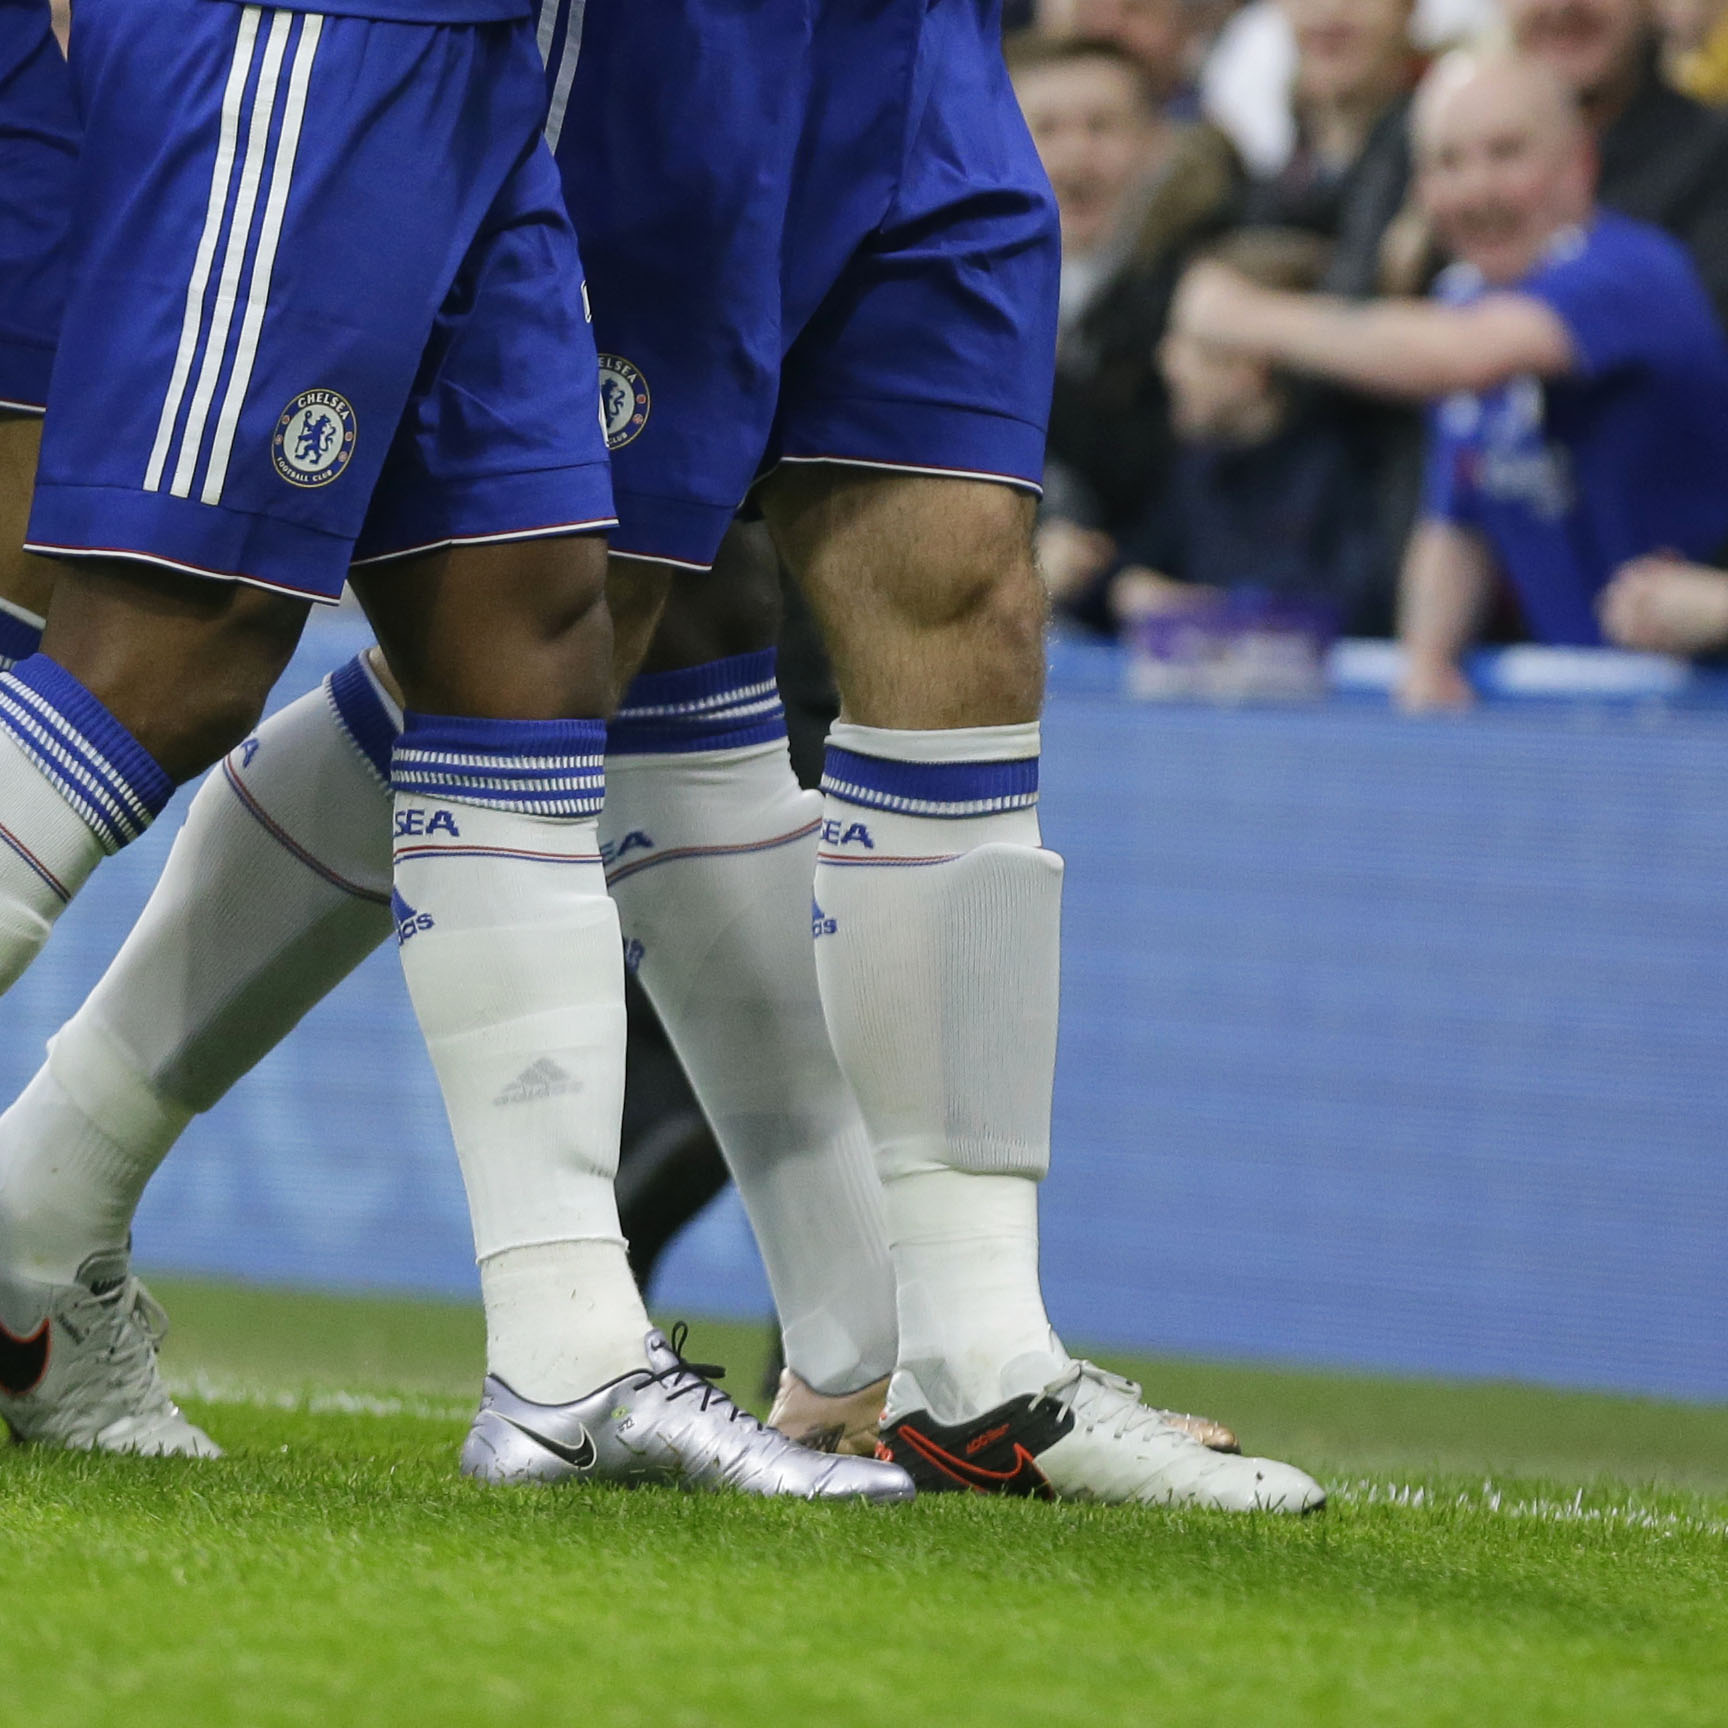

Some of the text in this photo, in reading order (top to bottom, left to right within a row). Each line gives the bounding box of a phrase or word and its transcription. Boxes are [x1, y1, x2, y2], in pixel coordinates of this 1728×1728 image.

[297, 392, 350, 421] CHELSEA
[276, 456, 333, 482] FOOTBALL CLUB
[394, 809, 460, 837] SEA
